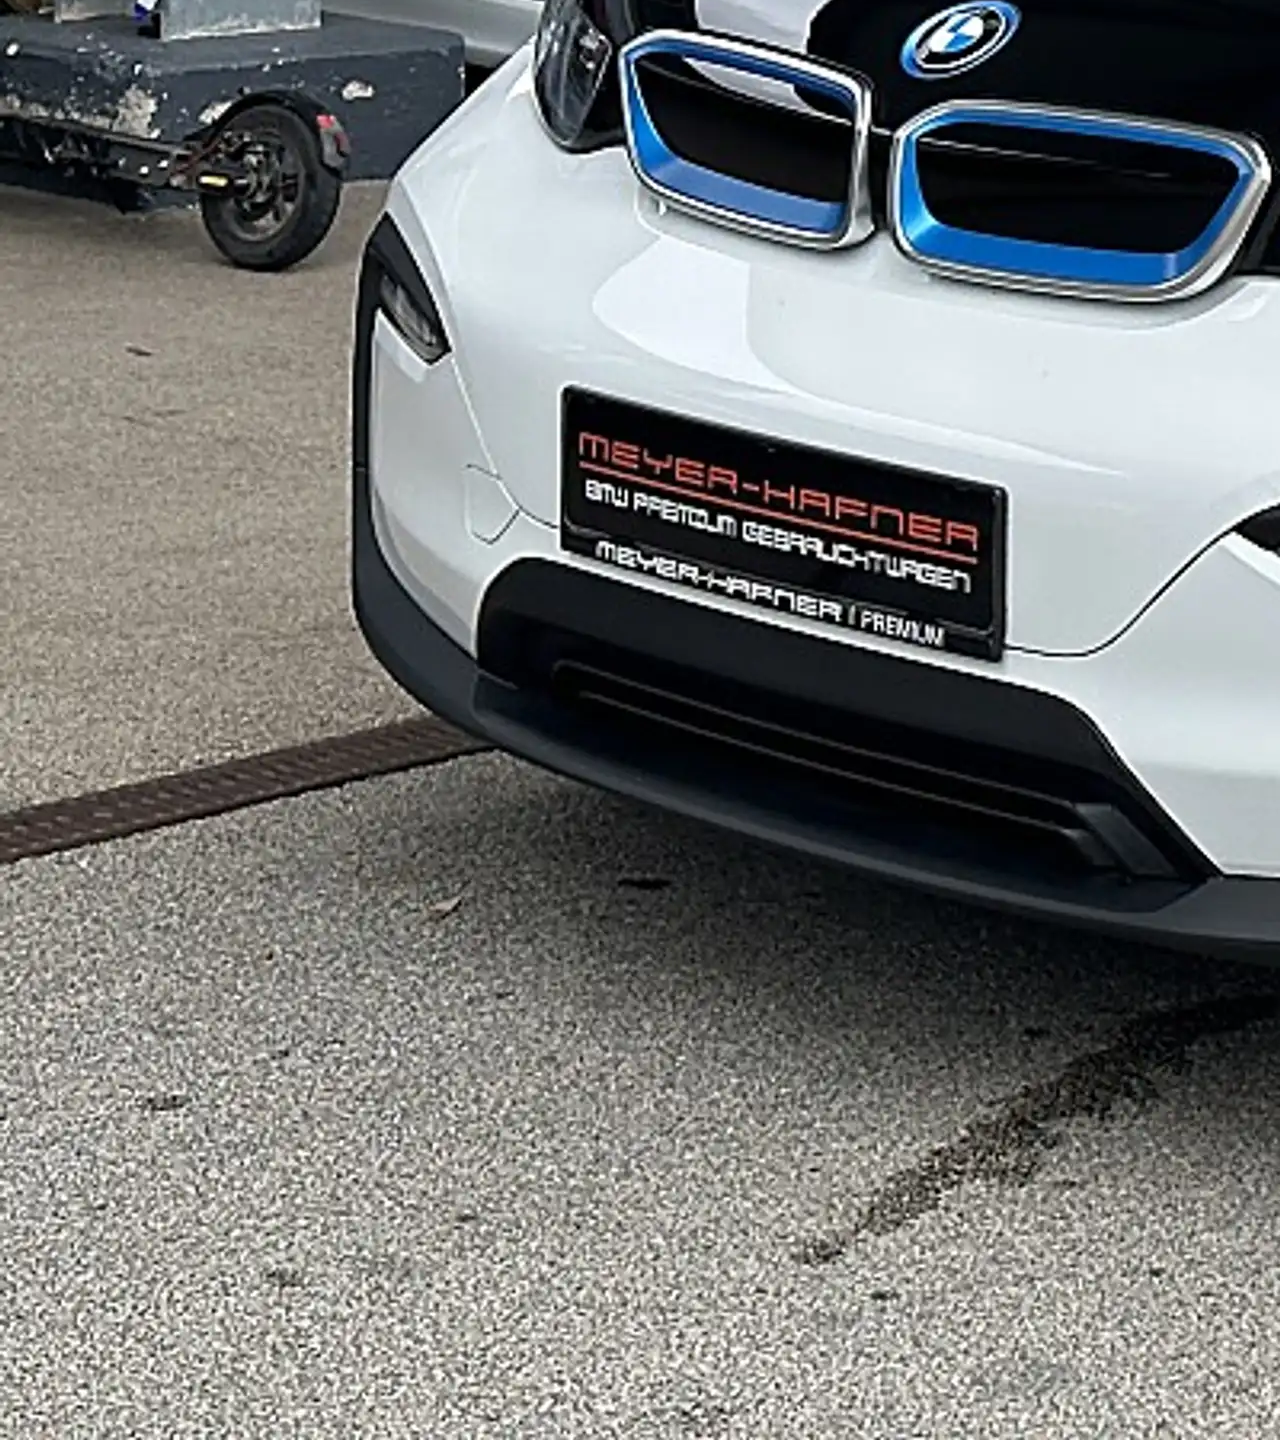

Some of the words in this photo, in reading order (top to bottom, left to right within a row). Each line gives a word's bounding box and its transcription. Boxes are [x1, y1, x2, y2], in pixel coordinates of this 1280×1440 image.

[578, 431, 980, 551] MEYER-HAFNER
[585, 478, 629, 509] BMW
[633, 491, 738, 537] PREMIUM
[742, 520, 972, 594] GEBRAUCHTWAGEN
[595, 540, 842, 622] MEYER-HAFNER
[860, 610, 946, 648] PREMIUM
